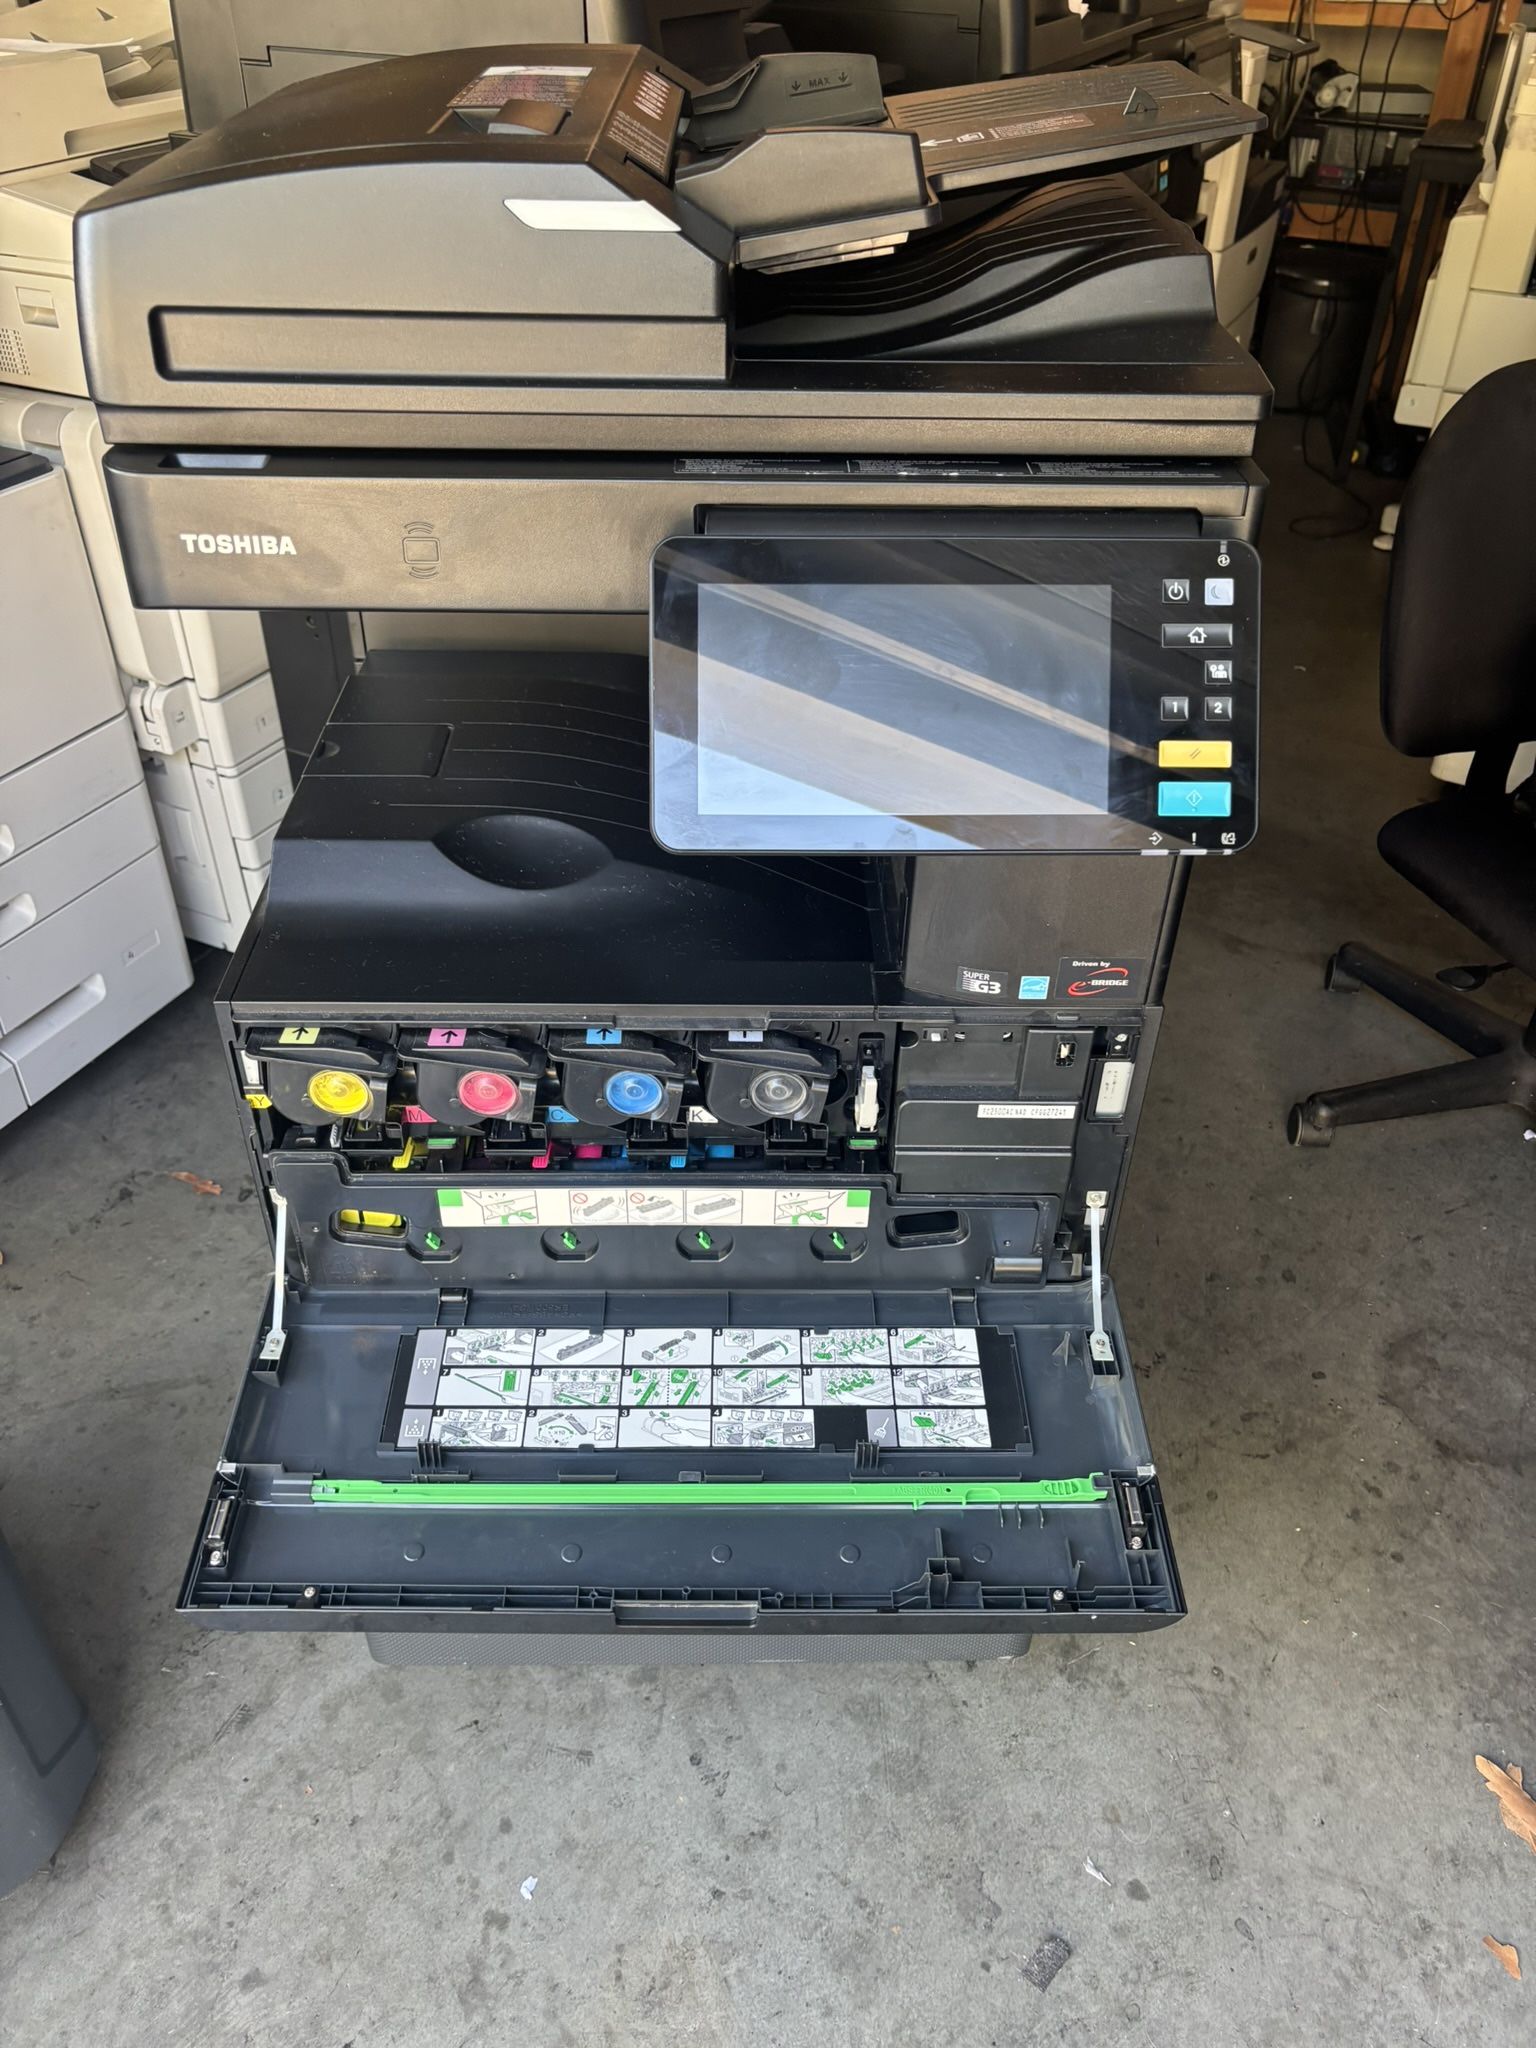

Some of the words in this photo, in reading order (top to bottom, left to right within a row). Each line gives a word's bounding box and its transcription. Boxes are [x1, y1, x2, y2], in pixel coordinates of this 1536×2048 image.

[808, 77, 831, 88] MAX
[180, 533, 297, 555] TOSHIBA
[1172, 702, 1178, 713] 1
[1214, 702, 1222, 713] 2
[1072, 960, 1098, 968] Driven
[1099, 961, 1111, 969] by
[963, 970, 990, 981] SUPER
[970, 980, 1001, 994] G3
[254, 1096, 265, 1106] Y
[408, 1110, 423, 1121] M
[551, 1109, 564, 1121] C
[691, 1110, 703, 1121] K
[713, 1368, 722, 1376] 10
[803, 1368, 811, 1376] 11
[892, 1368, 902, 1376] 12
